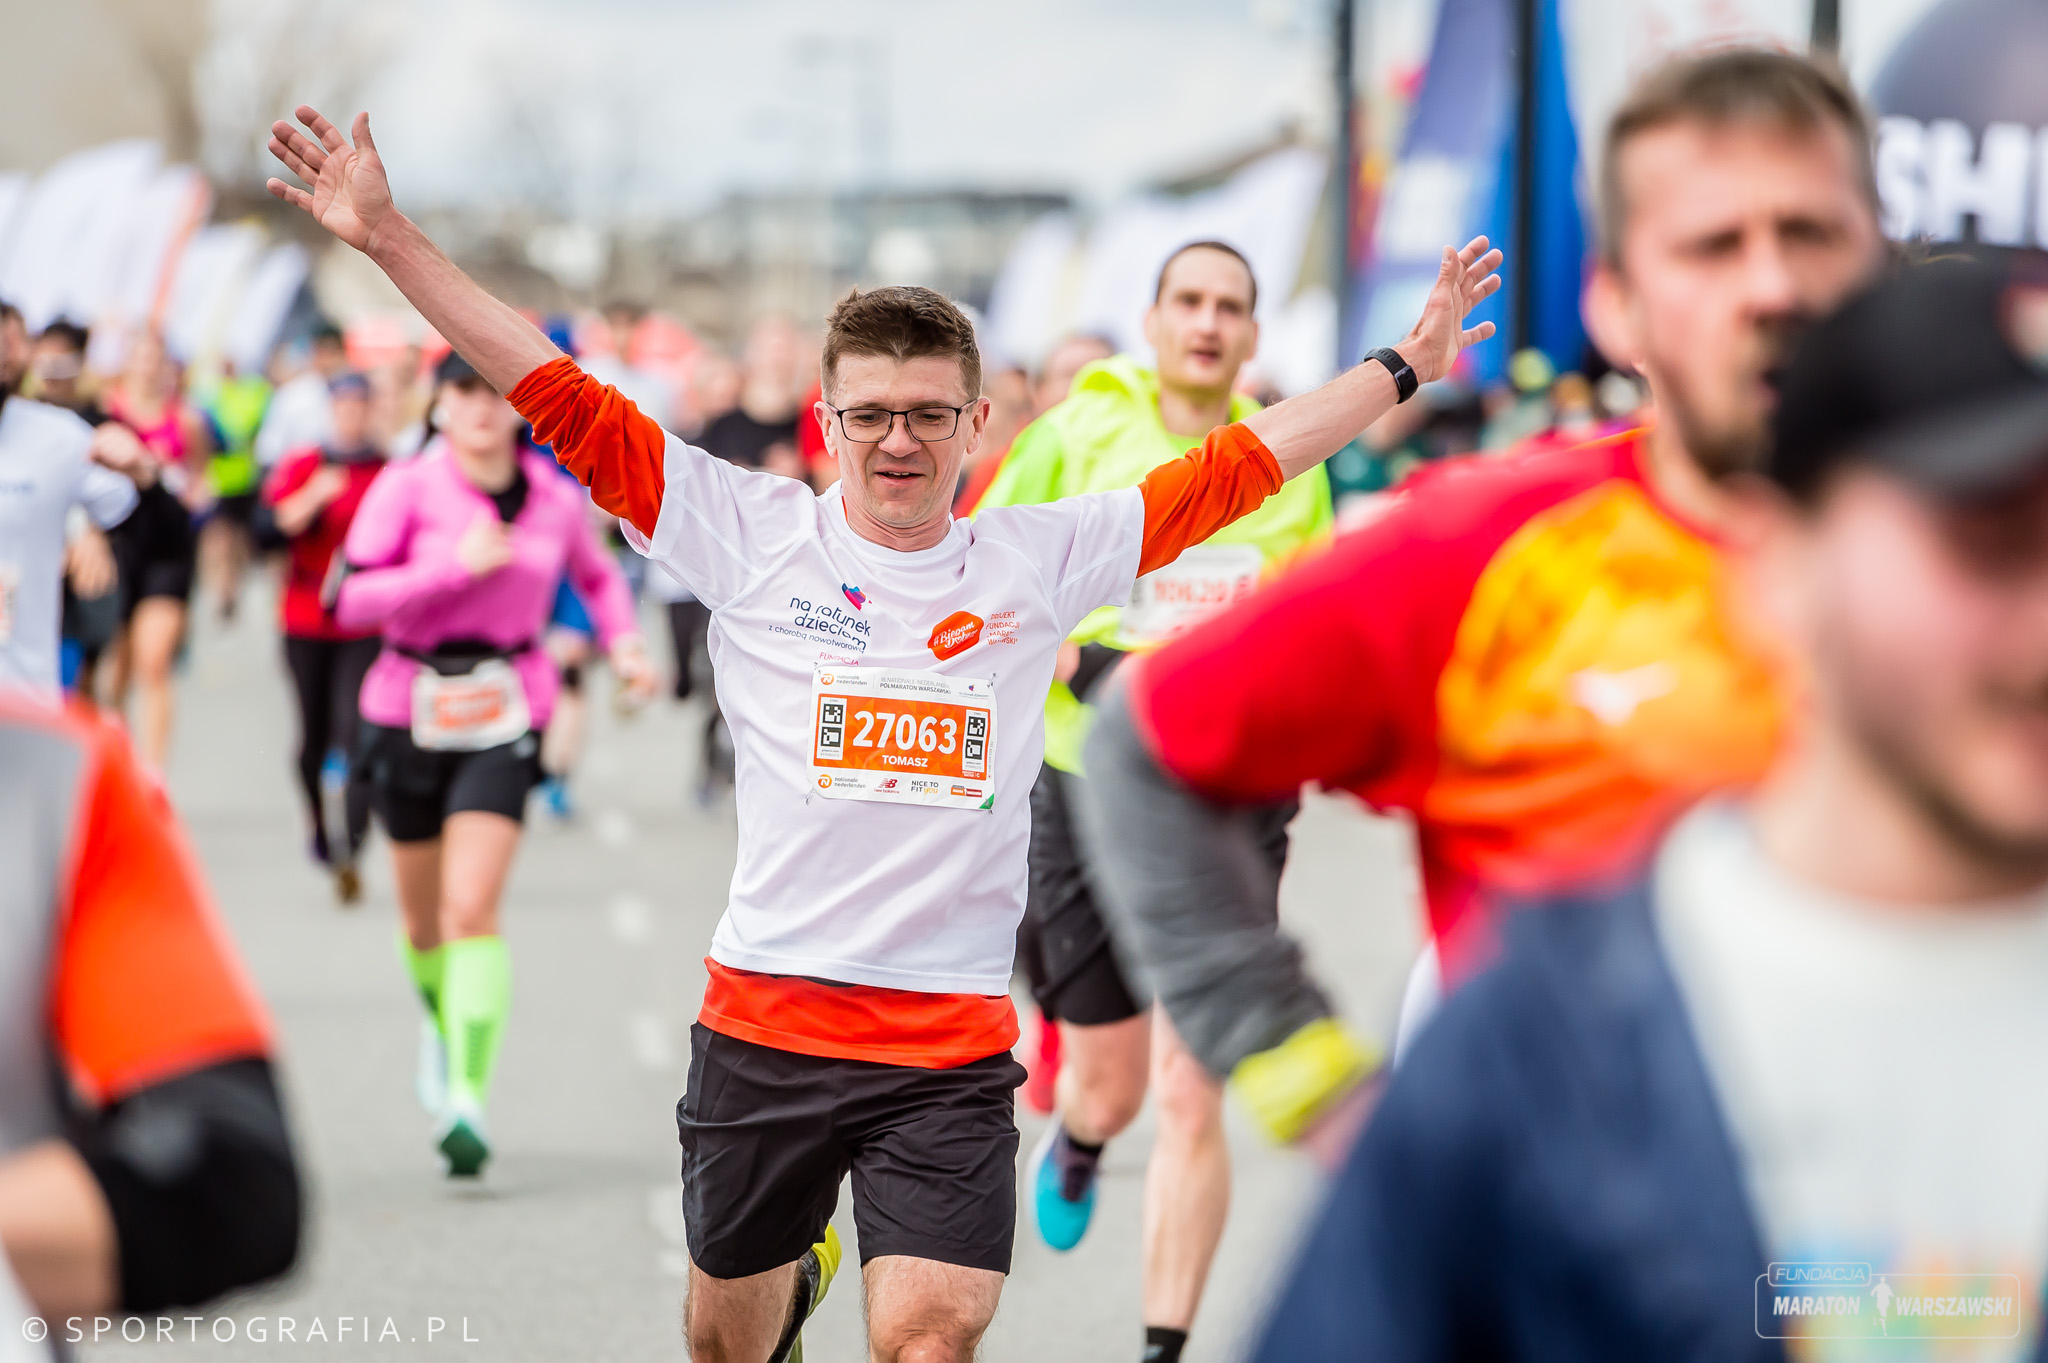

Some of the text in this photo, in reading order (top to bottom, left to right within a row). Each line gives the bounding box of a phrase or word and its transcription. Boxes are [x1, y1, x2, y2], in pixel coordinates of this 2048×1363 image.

[1876, 114, 2048, 250] SH
[790, 597, 872, 637] na ratunek
[794, 613, 867, 651] dzieciom
[853, 710, 957, 755] 27063
[882, 755, 928, 767] TOMASZ
[911, 780, 928, 788] NICE
[923, 787, 939, 795] you
